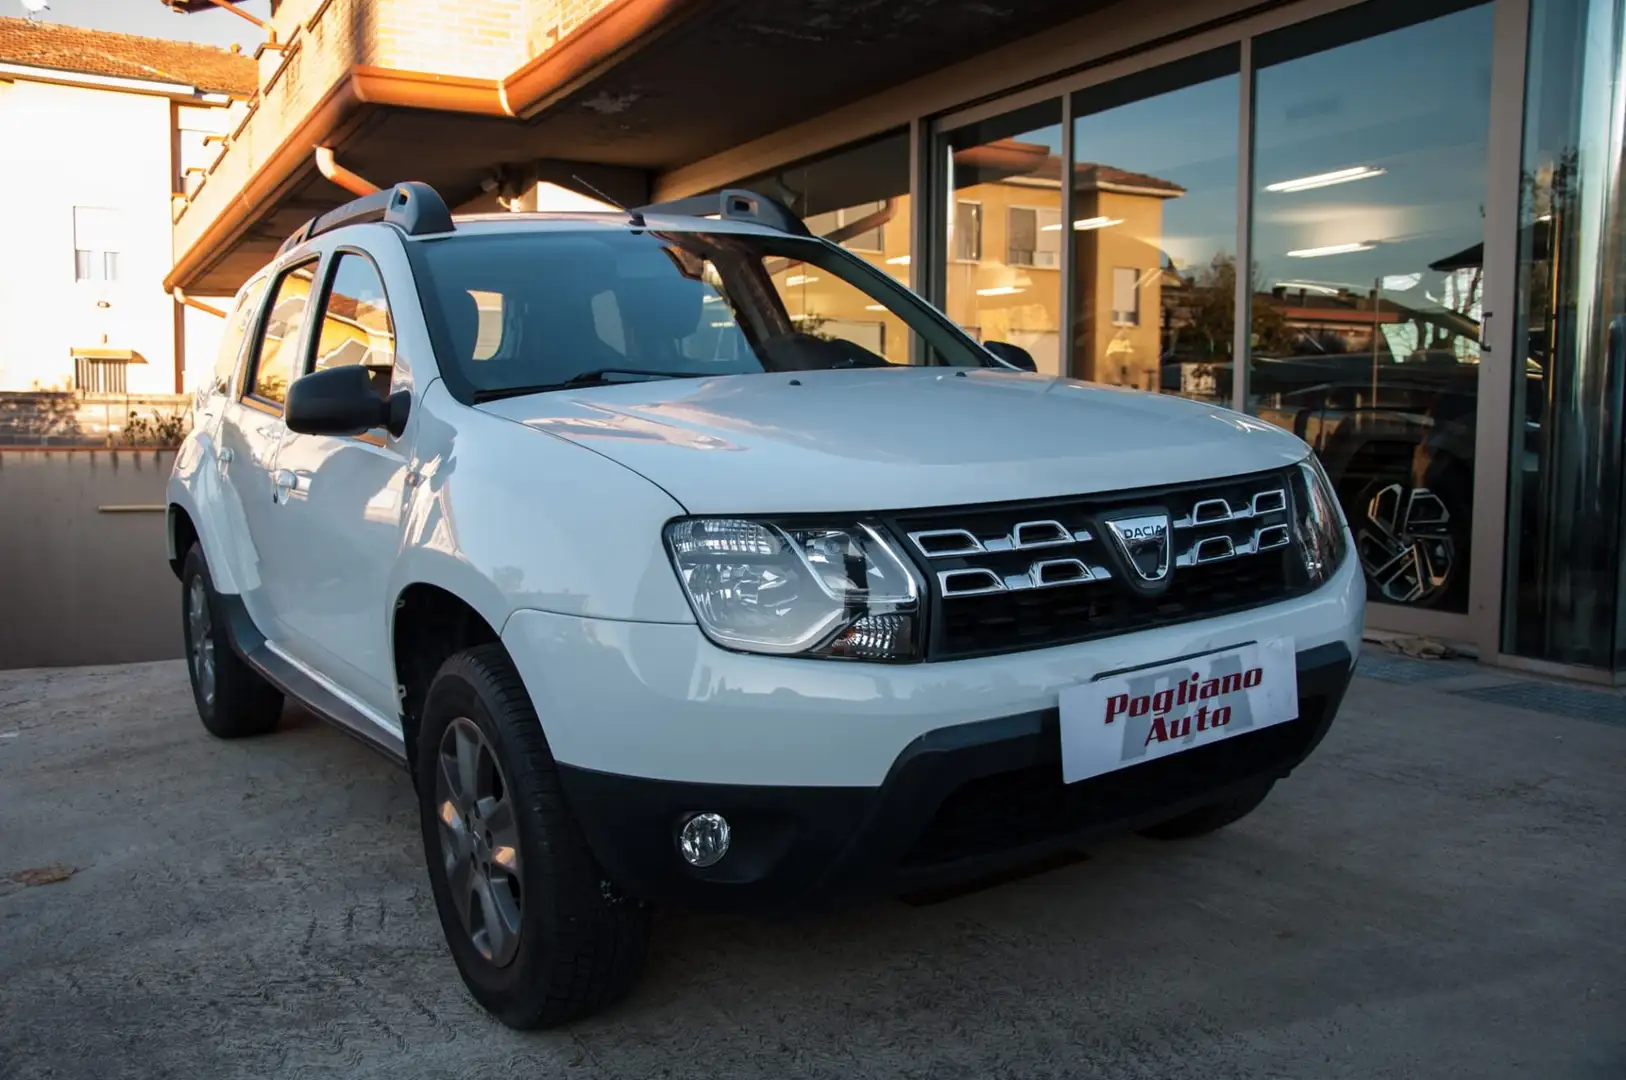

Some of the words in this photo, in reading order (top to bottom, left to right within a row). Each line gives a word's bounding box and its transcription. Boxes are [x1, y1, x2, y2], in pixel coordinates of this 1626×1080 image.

[1124, 525, 1164, 539] DACIA
[1105, 668, 1263, 724] Pogliano
[1144, 706, 1231, 747] Auto
